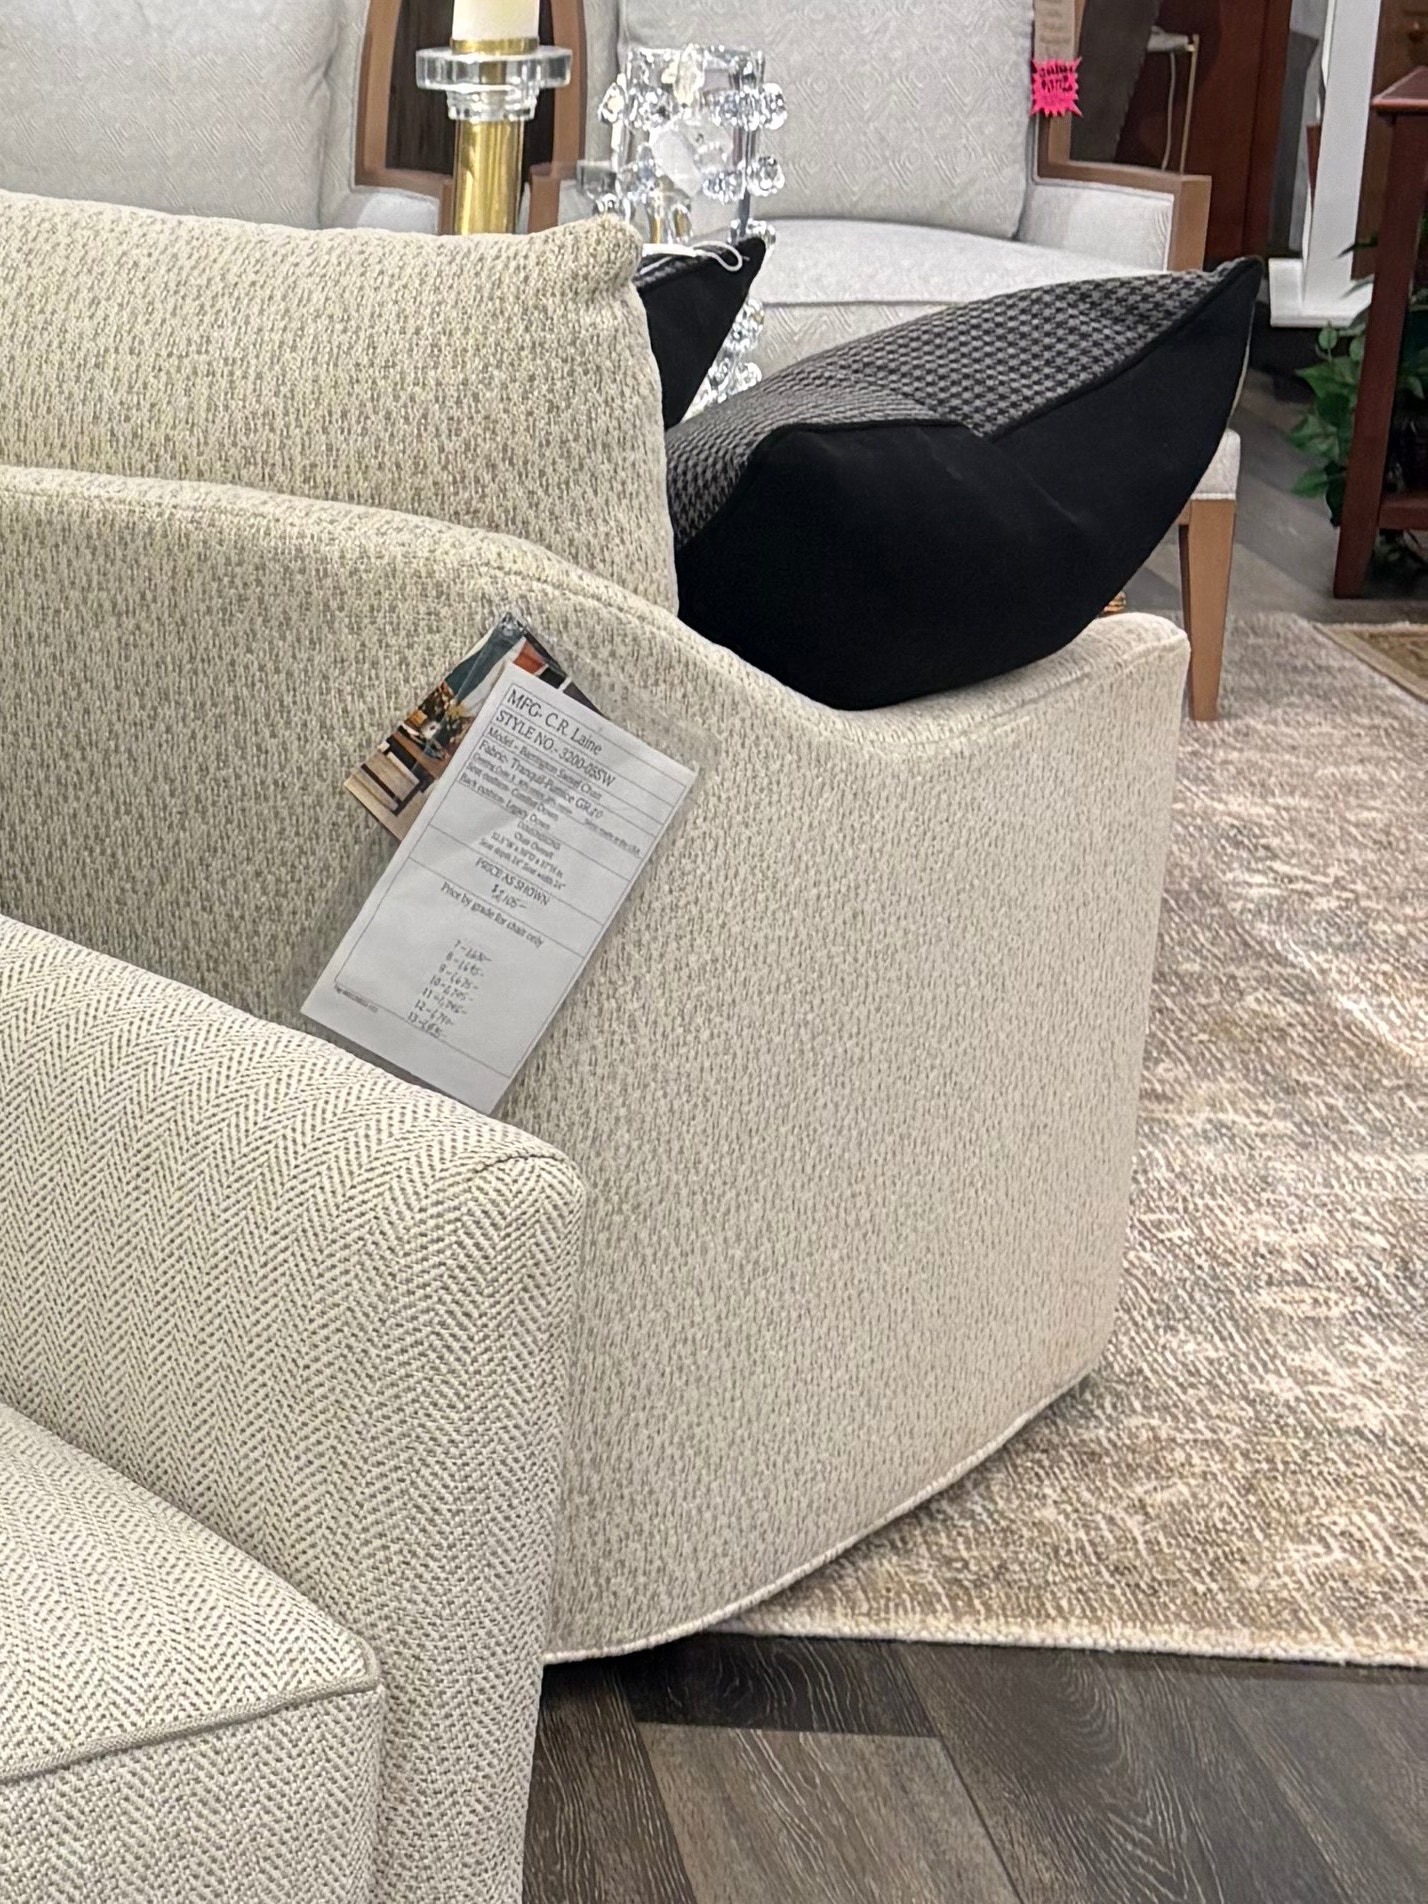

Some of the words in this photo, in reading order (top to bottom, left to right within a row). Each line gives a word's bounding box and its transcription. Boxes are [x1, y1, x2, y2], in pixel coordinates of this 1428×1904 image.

[496, 711, 535, 738] STYLE
[571, 729, 603, 755] Laine
[460, 893, 473, 906] by
[501, 872, 515, 885] AS
[515, 880, 548, 904] SHOWN
